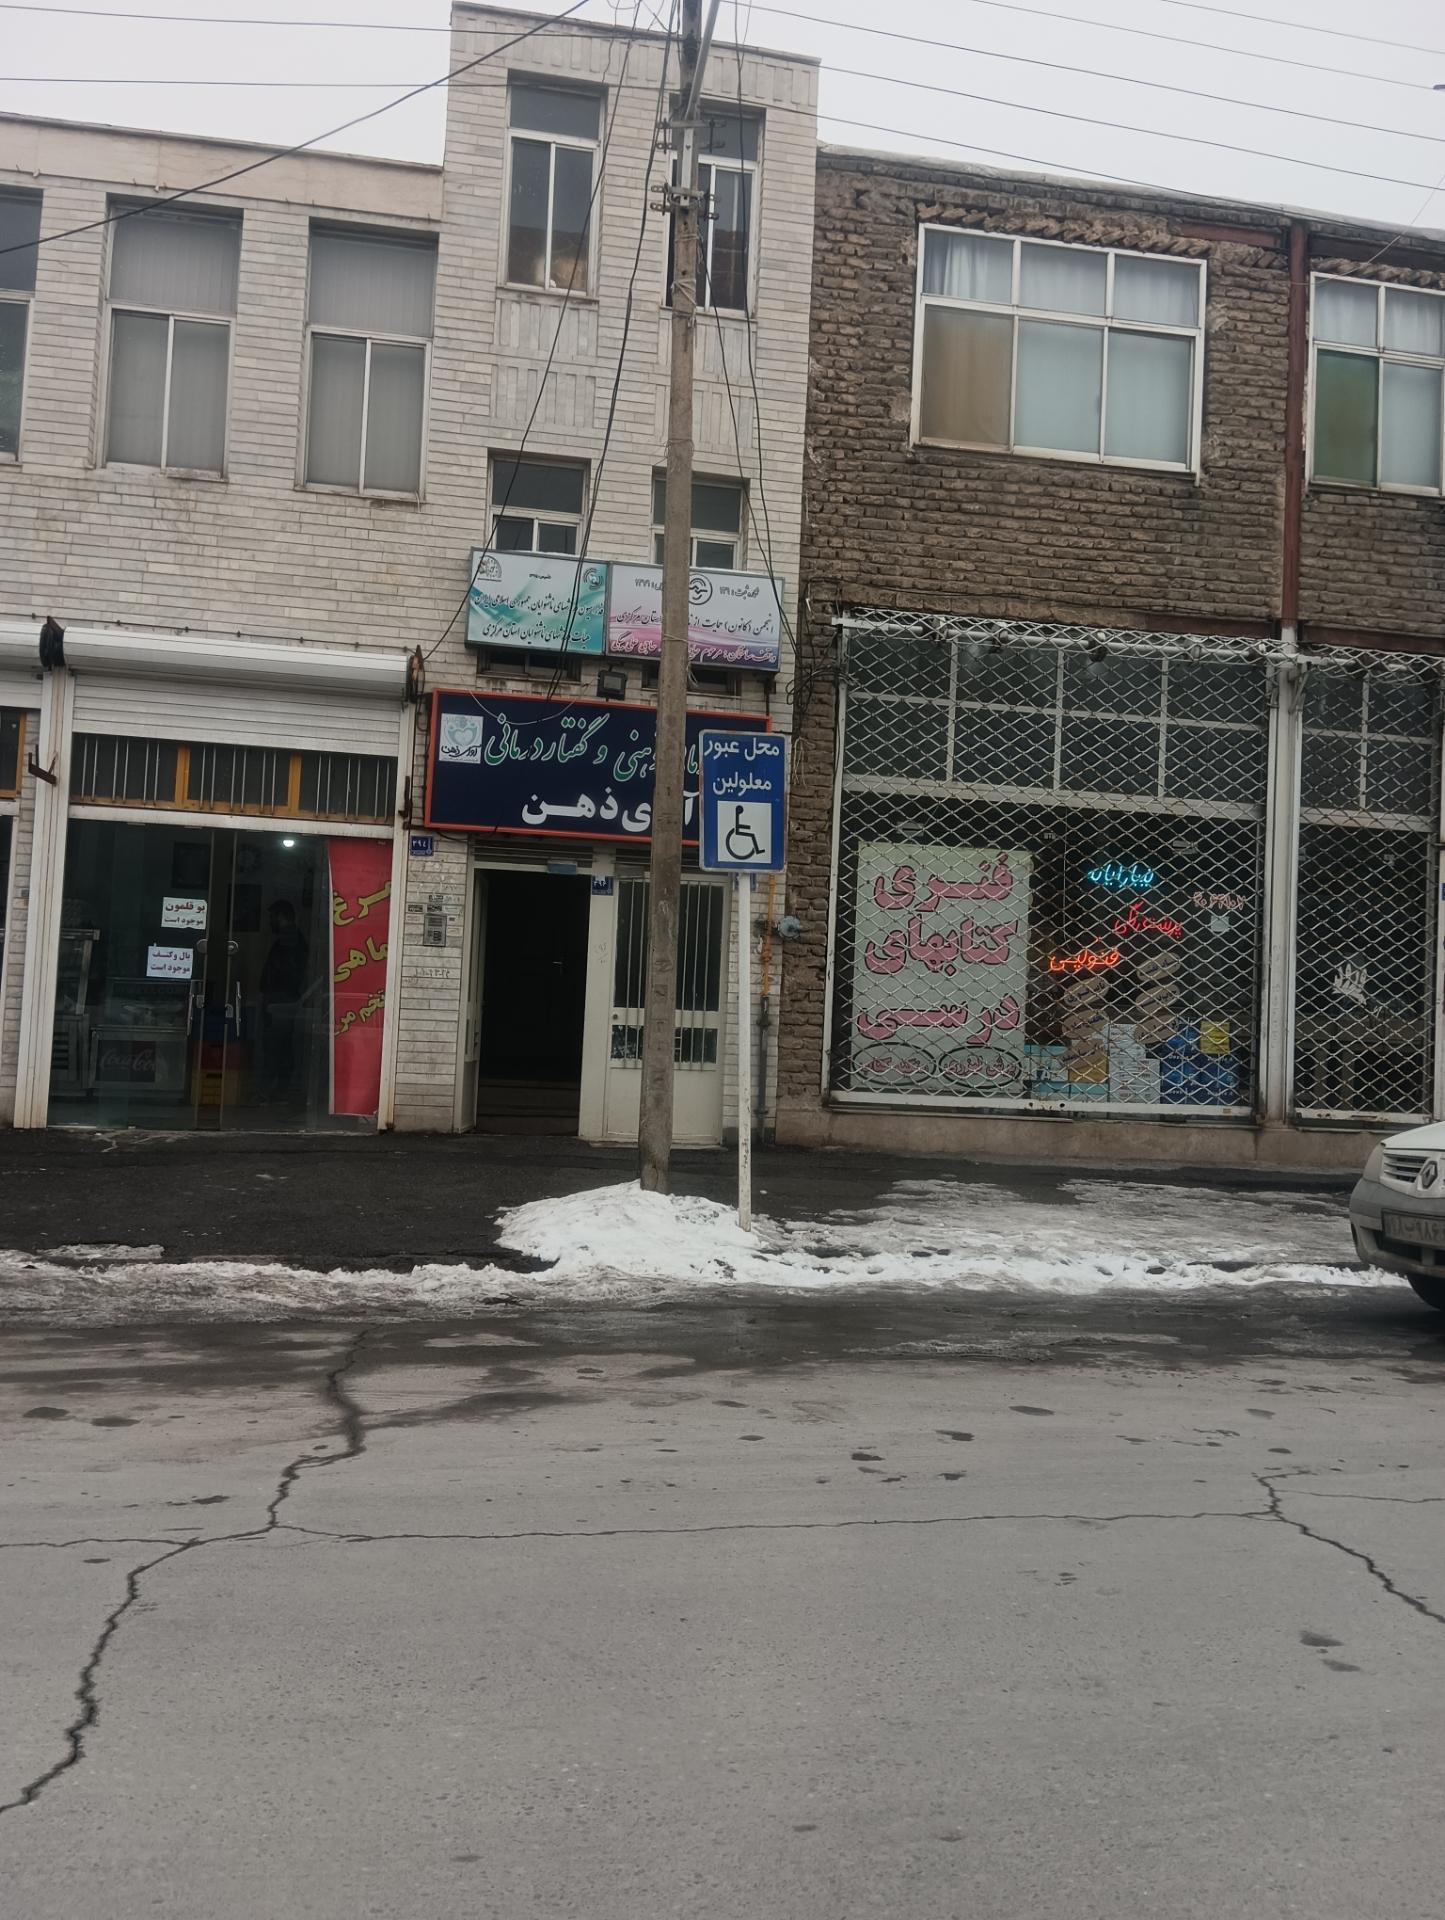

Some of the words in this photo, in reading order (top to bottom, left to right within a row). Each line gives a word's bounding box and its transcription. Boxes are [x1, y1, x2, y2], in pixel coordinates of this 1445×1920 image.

[752, 612, 774, 635] انجمن
[592, 744, 608, 765] و
[703, 738, 740, 761] عبور
[744, 737, 780, 761] محل
[712, 771, 772, 796] معلولین
[521, 786, 619, 825] ذهن
[874, 851, 1014, 912] فنری
[864, 913, 1019, 977] کتابهای
[150, 963, 167, 971] است
[167, 964, 190, 974] موجود
[334, 1010, 356, 1037] مر
[856, 993, 1021, 1045] درسی
